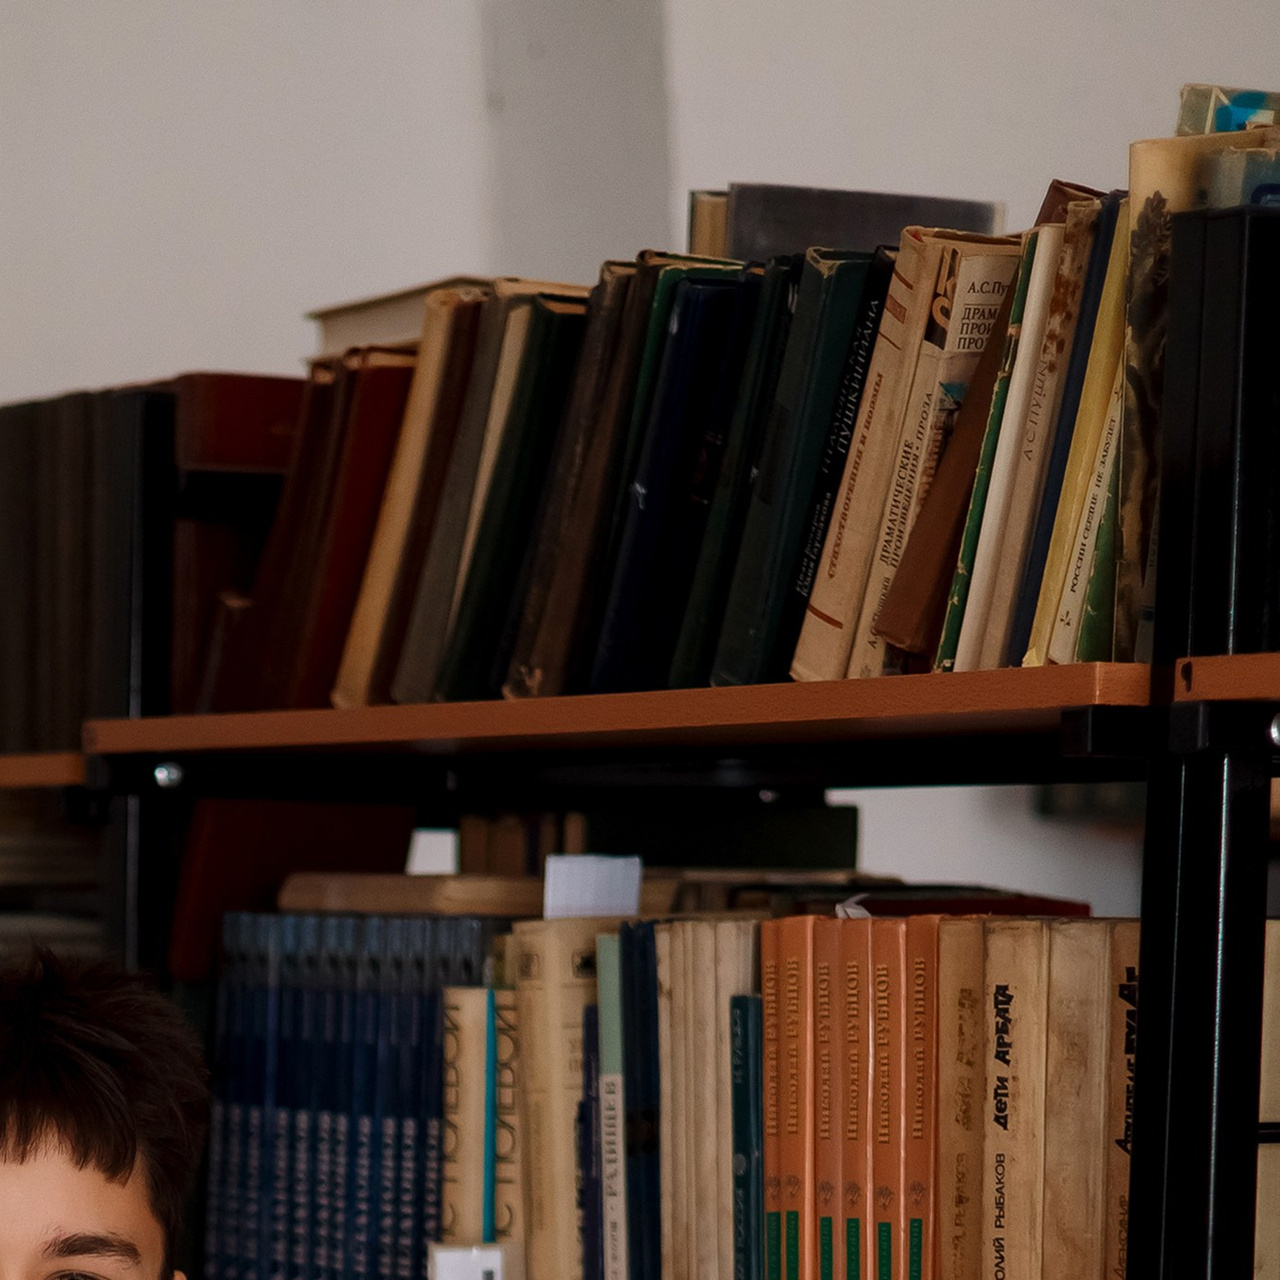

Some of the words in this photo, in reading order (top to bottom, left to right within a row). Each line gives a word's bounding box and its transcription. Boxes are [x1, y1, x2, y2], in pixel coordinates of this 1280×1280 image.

[836, 300, 879, 453] ПУШКИНИАНА
[915, 391, 932, 441] ПРОЗА
[1094, 472, 1105, 488] НЕ
[1099, 417, 1117, 468] ЗАБУДЕТ
[827, 448, 863, 579] СТИХОТВОРЕНИЯ
[859, 434, 868, 446] И
[879, 439, 914, 565] ДРАМАТИЧЕСКИЕ
[1081, 492, 1099, 540] СЕРДЦЕ
[1070, 542, 1086, 593] РОССИИ
[765, 960, 779, 1041] РУБЦОВ
[786, 958, 801, 1039] РУБЦОВ
[819, 962, 833, 1044] РУБЦОВ
[847, 961, 861, 1044] РУБЦОВ
[876, 963, 891, 1047] РУБЦОВ
[914, 959, 928, 1041] РУБЦОВ
[993, 984, 1014, 1067] АРБАТА
[993, 1152, 1006, 1230] РЫБАКОВ
